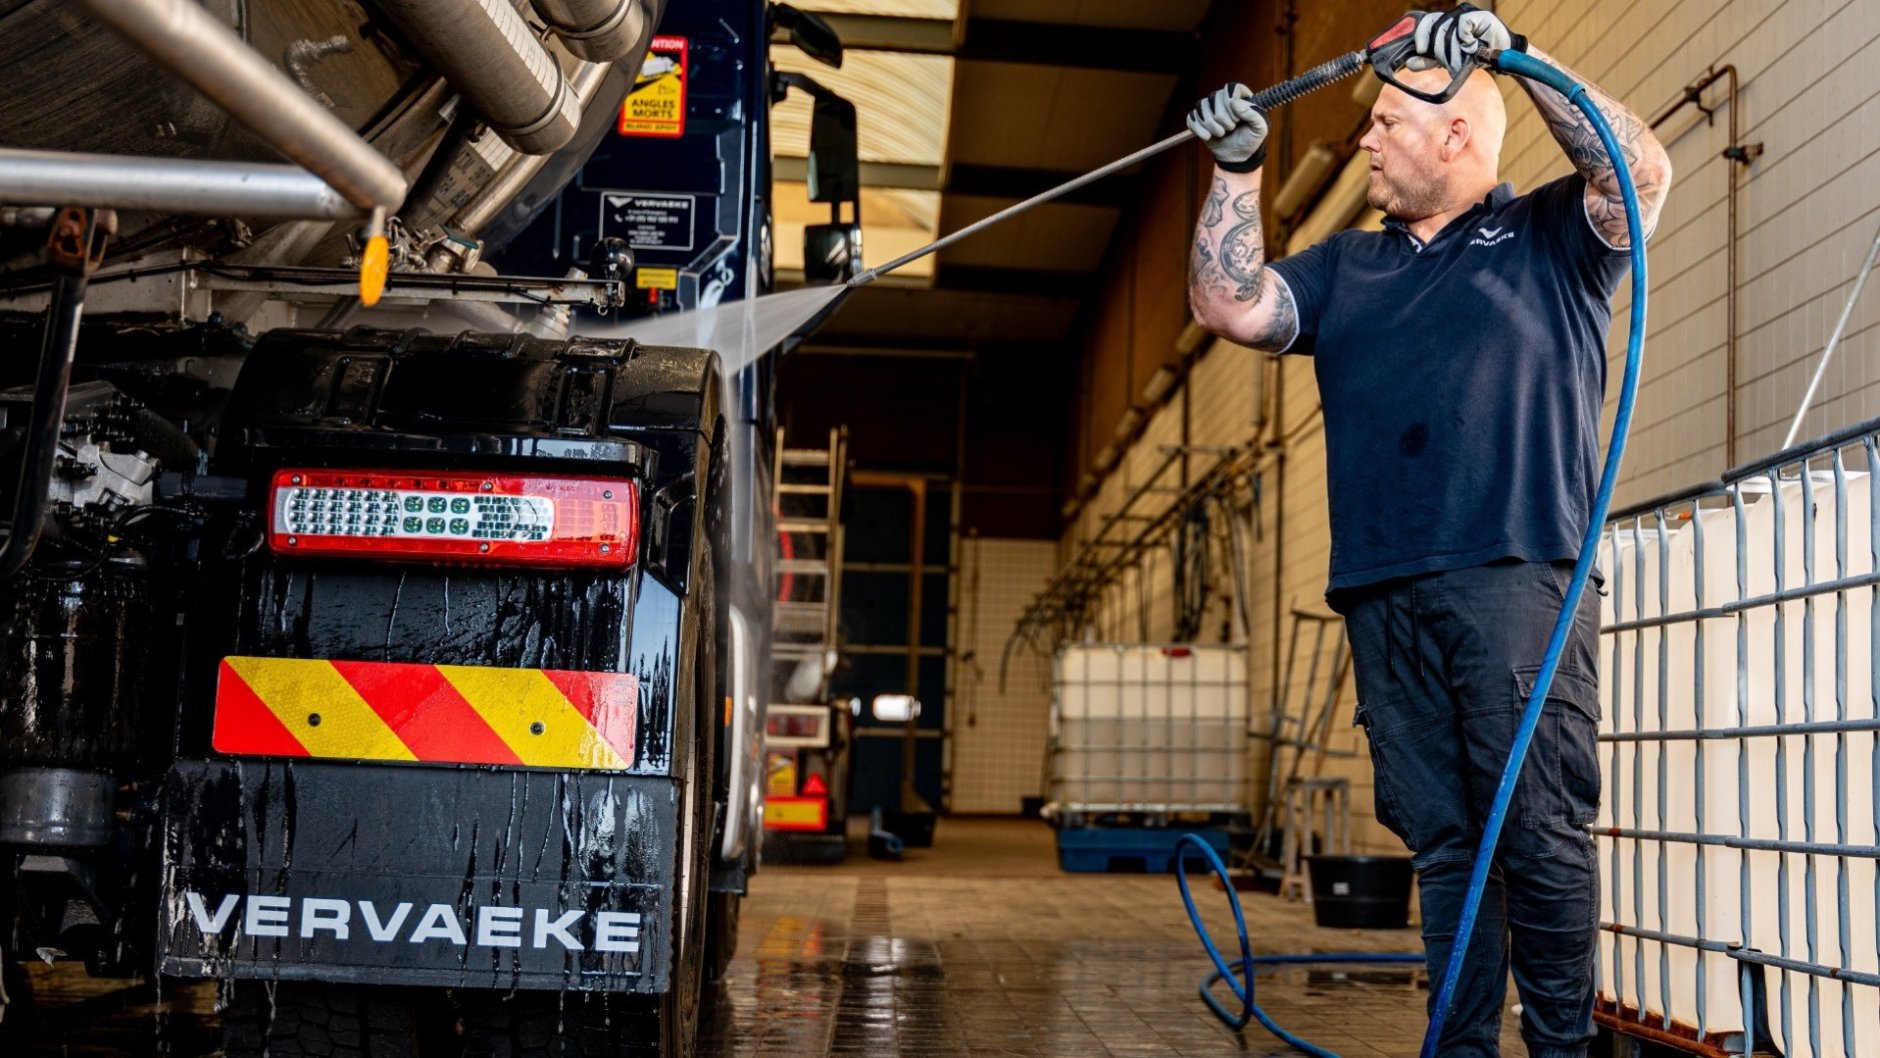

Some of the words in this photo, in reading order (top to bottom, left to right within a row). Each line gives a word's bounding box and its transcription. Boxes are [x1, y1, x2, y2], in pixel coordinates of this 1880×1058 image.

[632, 99, 675, 109] ANGLES
[633, 109, 673, 119] MORTS
[634, 199, 689, 208] VERVAEKE
[1469, 232, 1515, 246] ERVAEKE
[186, 892, 641, 952] VERVAEKE
